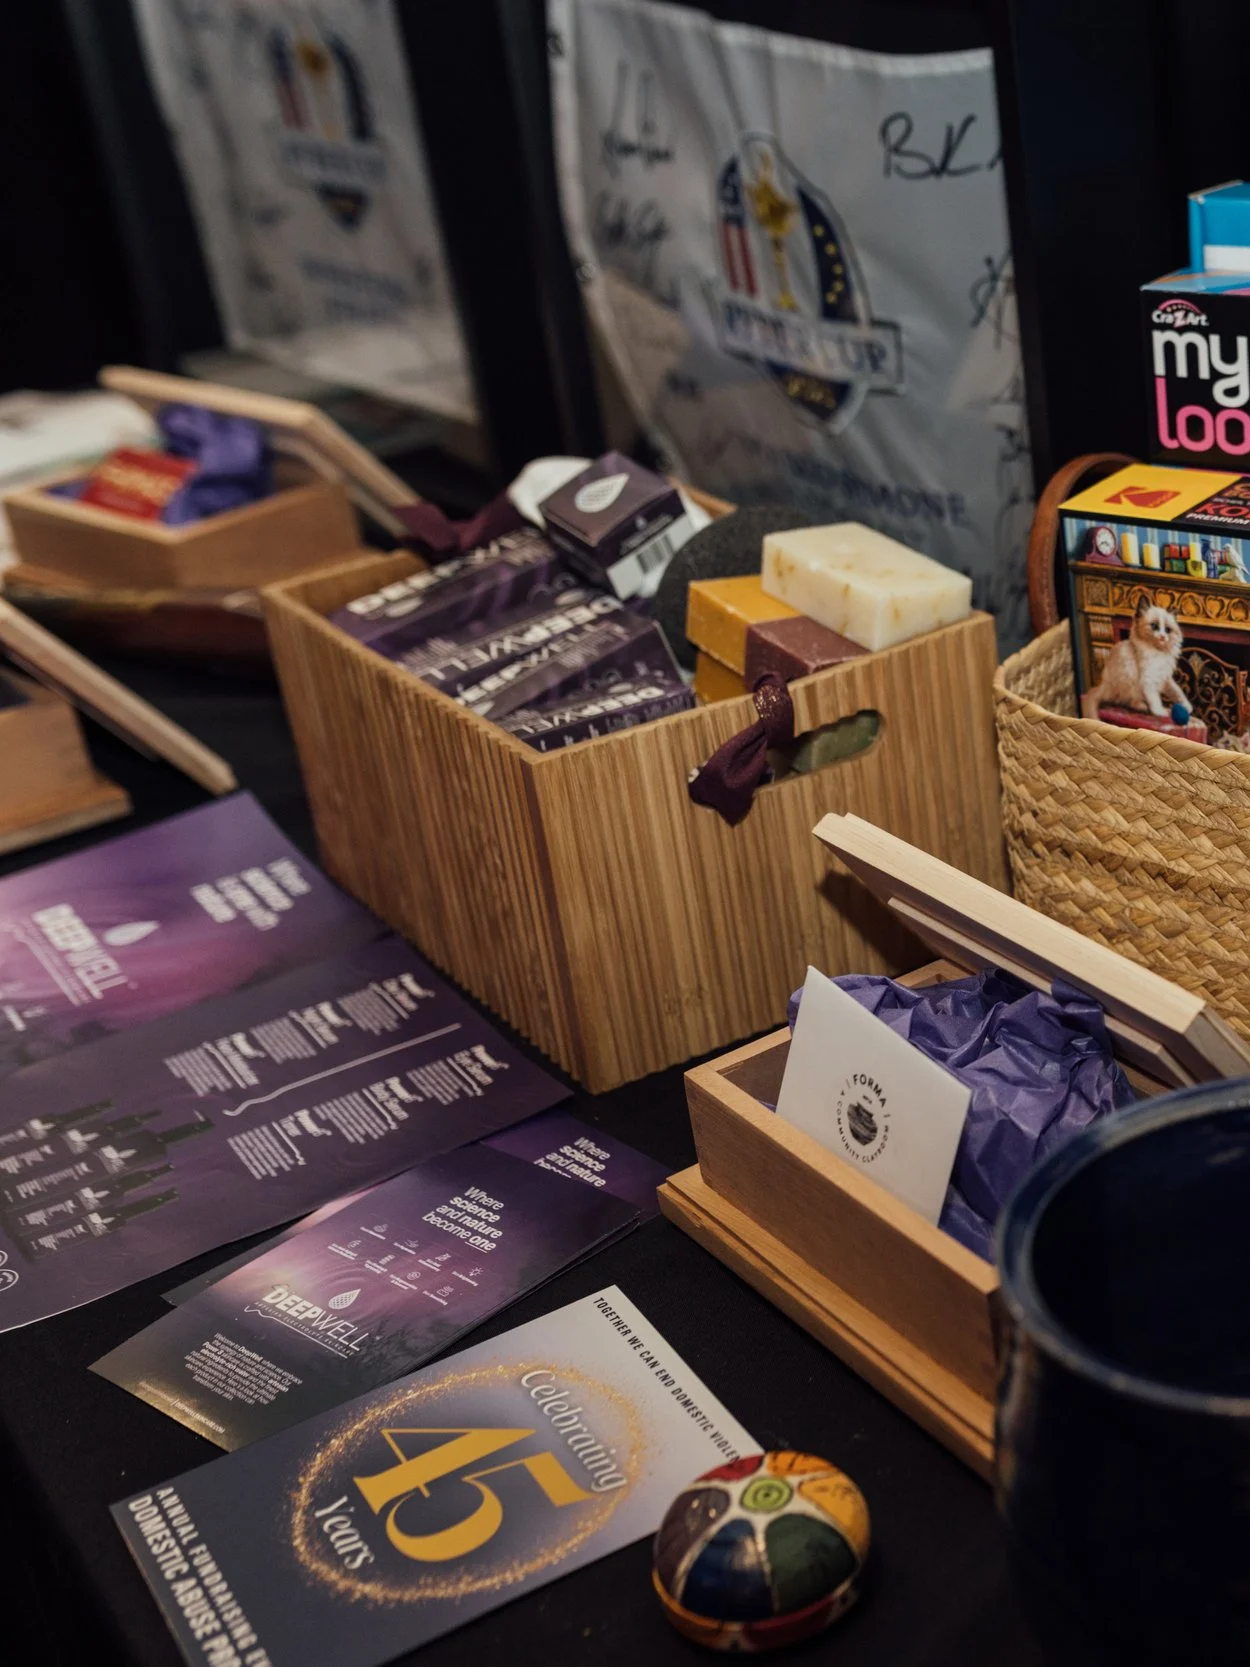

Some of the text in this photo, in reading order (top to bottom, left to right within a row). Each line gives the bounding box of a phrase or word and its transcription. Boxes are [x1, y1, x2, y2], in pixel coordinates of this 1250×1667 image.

[1152, 329, 1250, 409] my
[1186, 513, 1250, 526] PREMIUM
[853, 1073, 887, 1108] FORMA
[559, 1145, 606, 1172] science
[574, 1136, 611, 1160] Where
[545, 1152, 574, 1167] and
[565, 1163, 607, 1187] nature
[450, 1196, 501, 1223] science
[464, 1186, 505, 1211] Where
[422, 1211, 497, 1251] become one
[436, 1204, 503, 1239] and nature
[262, 1287, 369, 1352] DEEPWELL
[593, 1297, 741, 1463] TOGETHER WE CAN END DOMESTIC VIOLEN
[521, 1370, 628, 1493] Celebrating
[353, 1428, 594, 1562] 45
[314, 1495, 374, 1569] Years
[128, 1494, 190, 1580] DOMESTIC
[170, 1577, 222, 1641] ABUSE
[156, 1486, 199, 1546] ANNUAL
[188, 1543, 258, 1651] FUNDRAISING
